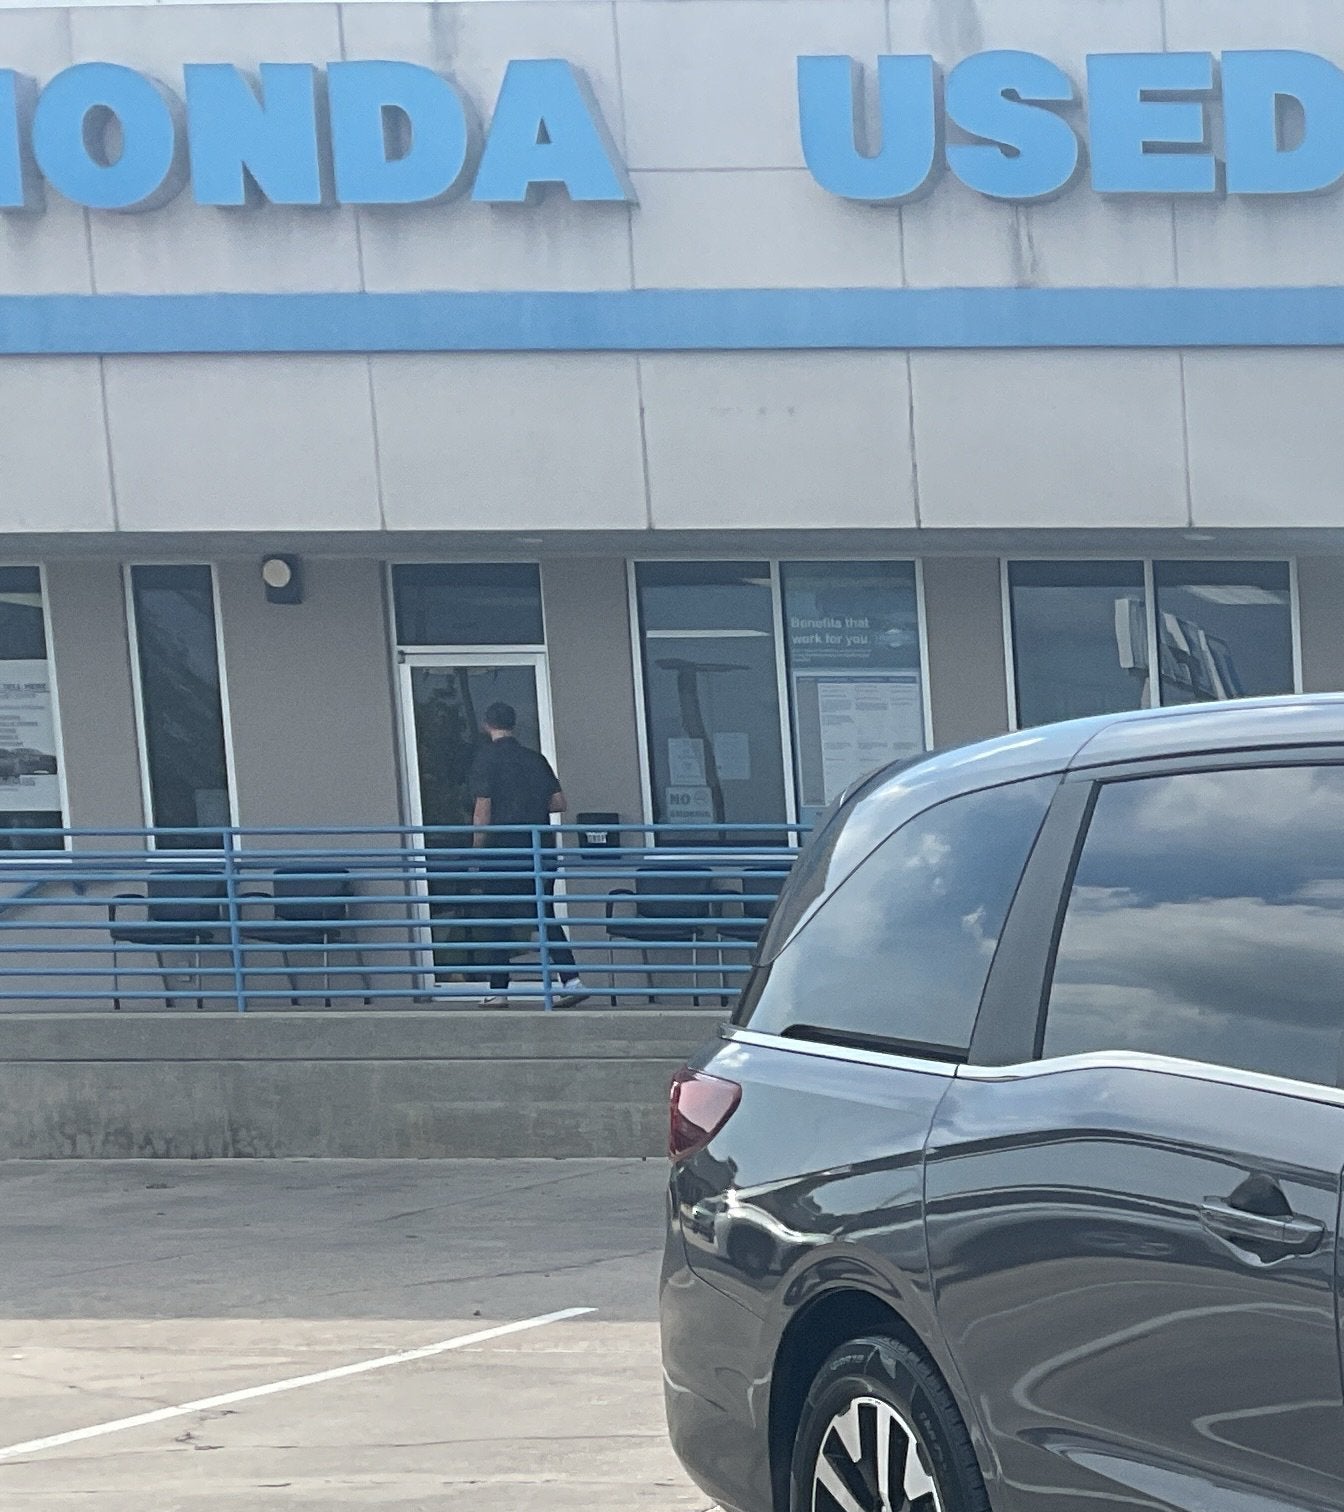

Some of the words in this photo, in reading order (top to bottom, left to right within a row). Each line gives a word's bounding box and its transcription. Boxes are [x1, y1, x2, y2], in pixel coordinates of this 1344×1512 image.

[791, 617, 842, 628] Benefits
[845, 617, 869, 628] that
[792, 634, 822, 644] work
[826, 634, 842, 644] for
[846, 635, 868, 646] you
[669, 793, 692, 805] NO
